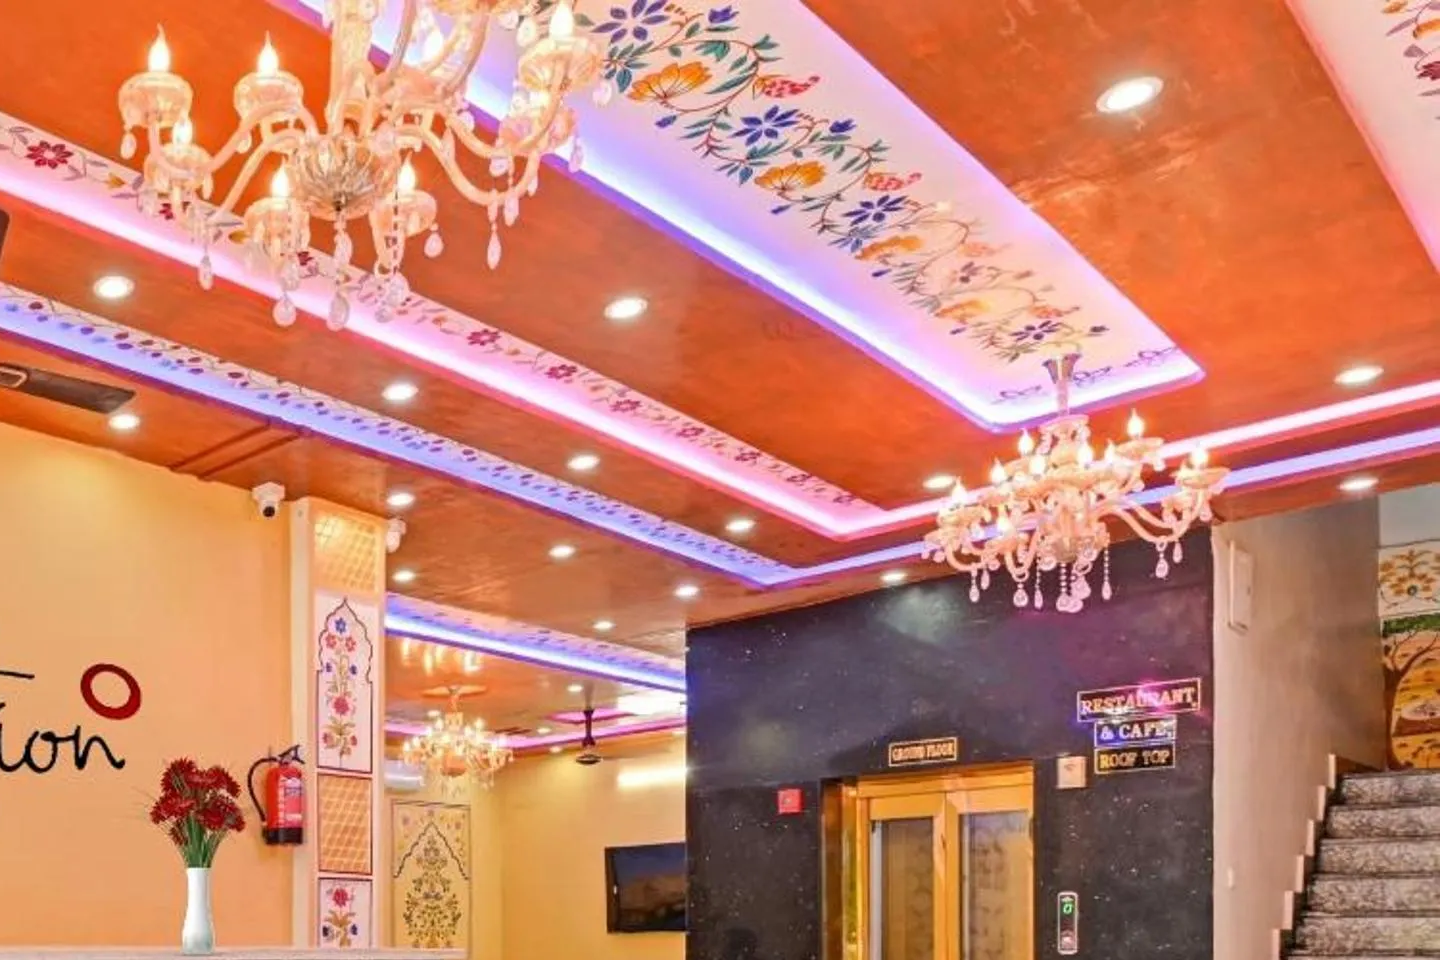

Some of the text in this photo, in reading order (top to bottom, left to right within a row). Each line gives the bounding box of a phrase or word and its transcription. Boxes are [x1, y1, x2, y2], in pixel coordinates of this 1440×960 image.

[1080, 687, 1196, 715] RESTAURANT
[1101, 725, 1114, 740] &
[1100, 750, 1170, 769] ROOF TOP
